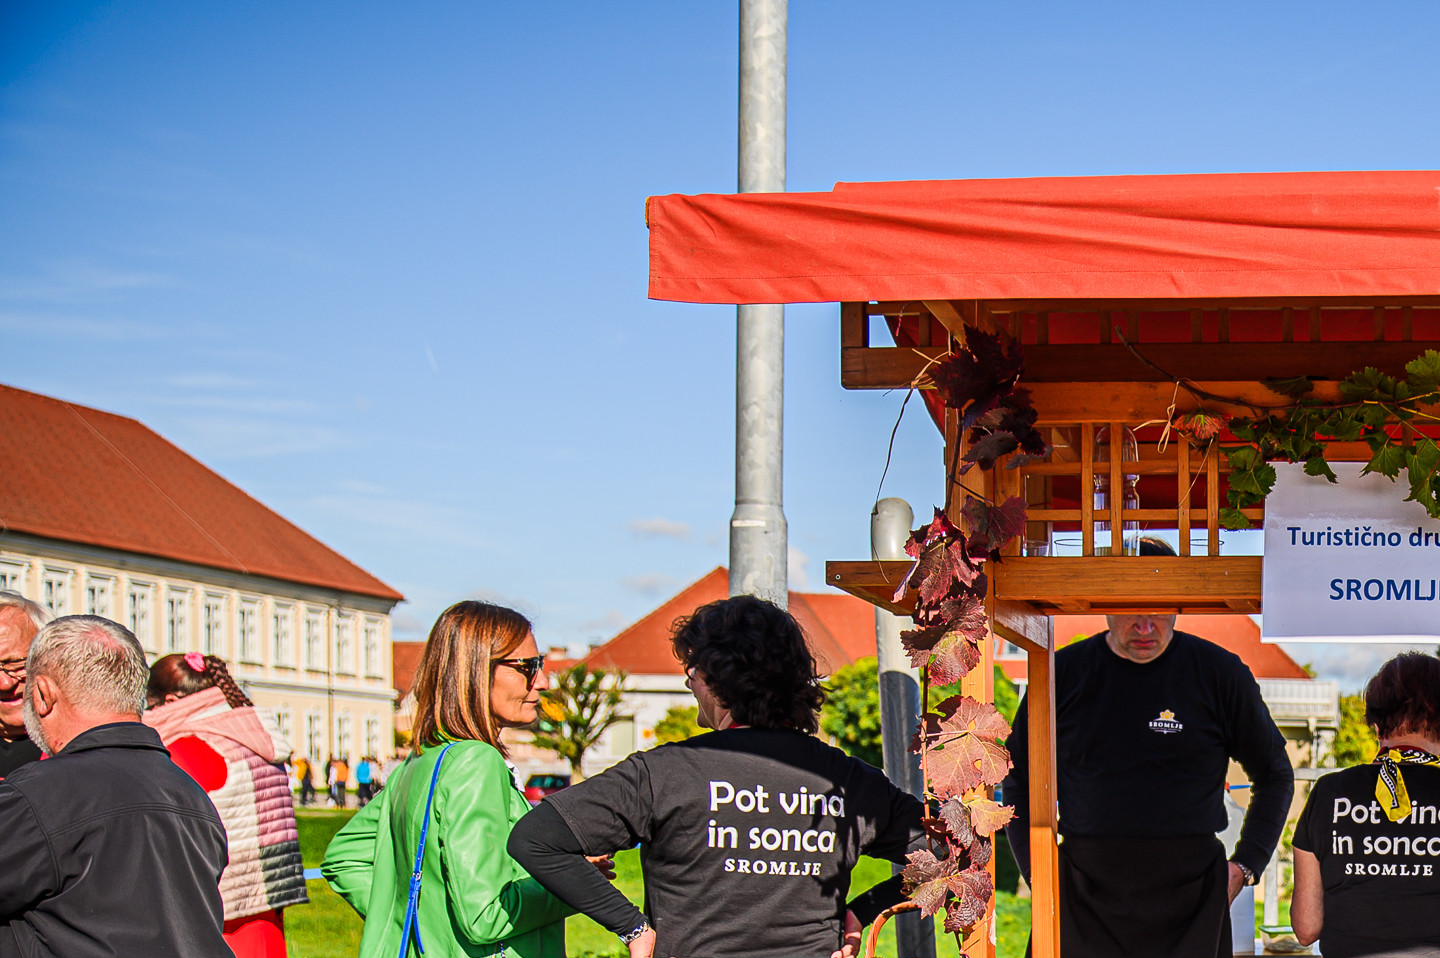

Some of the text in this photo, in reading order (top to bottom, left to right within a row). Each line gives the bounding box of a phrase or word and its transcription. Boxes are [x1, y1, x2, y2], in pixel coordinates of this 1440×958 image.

[1287, 526, 1402, 547] Turistično
[709, 780, 846, 818] Pot vina
[1332, 797, 1381, 824] Pot
[707, 819, 836, 853] in sonca
[1332, 830, 1354, 855] in
[724, 857, 822, 876] SROMLJE
[1344, 863, 1434, 876] SROMLJE
